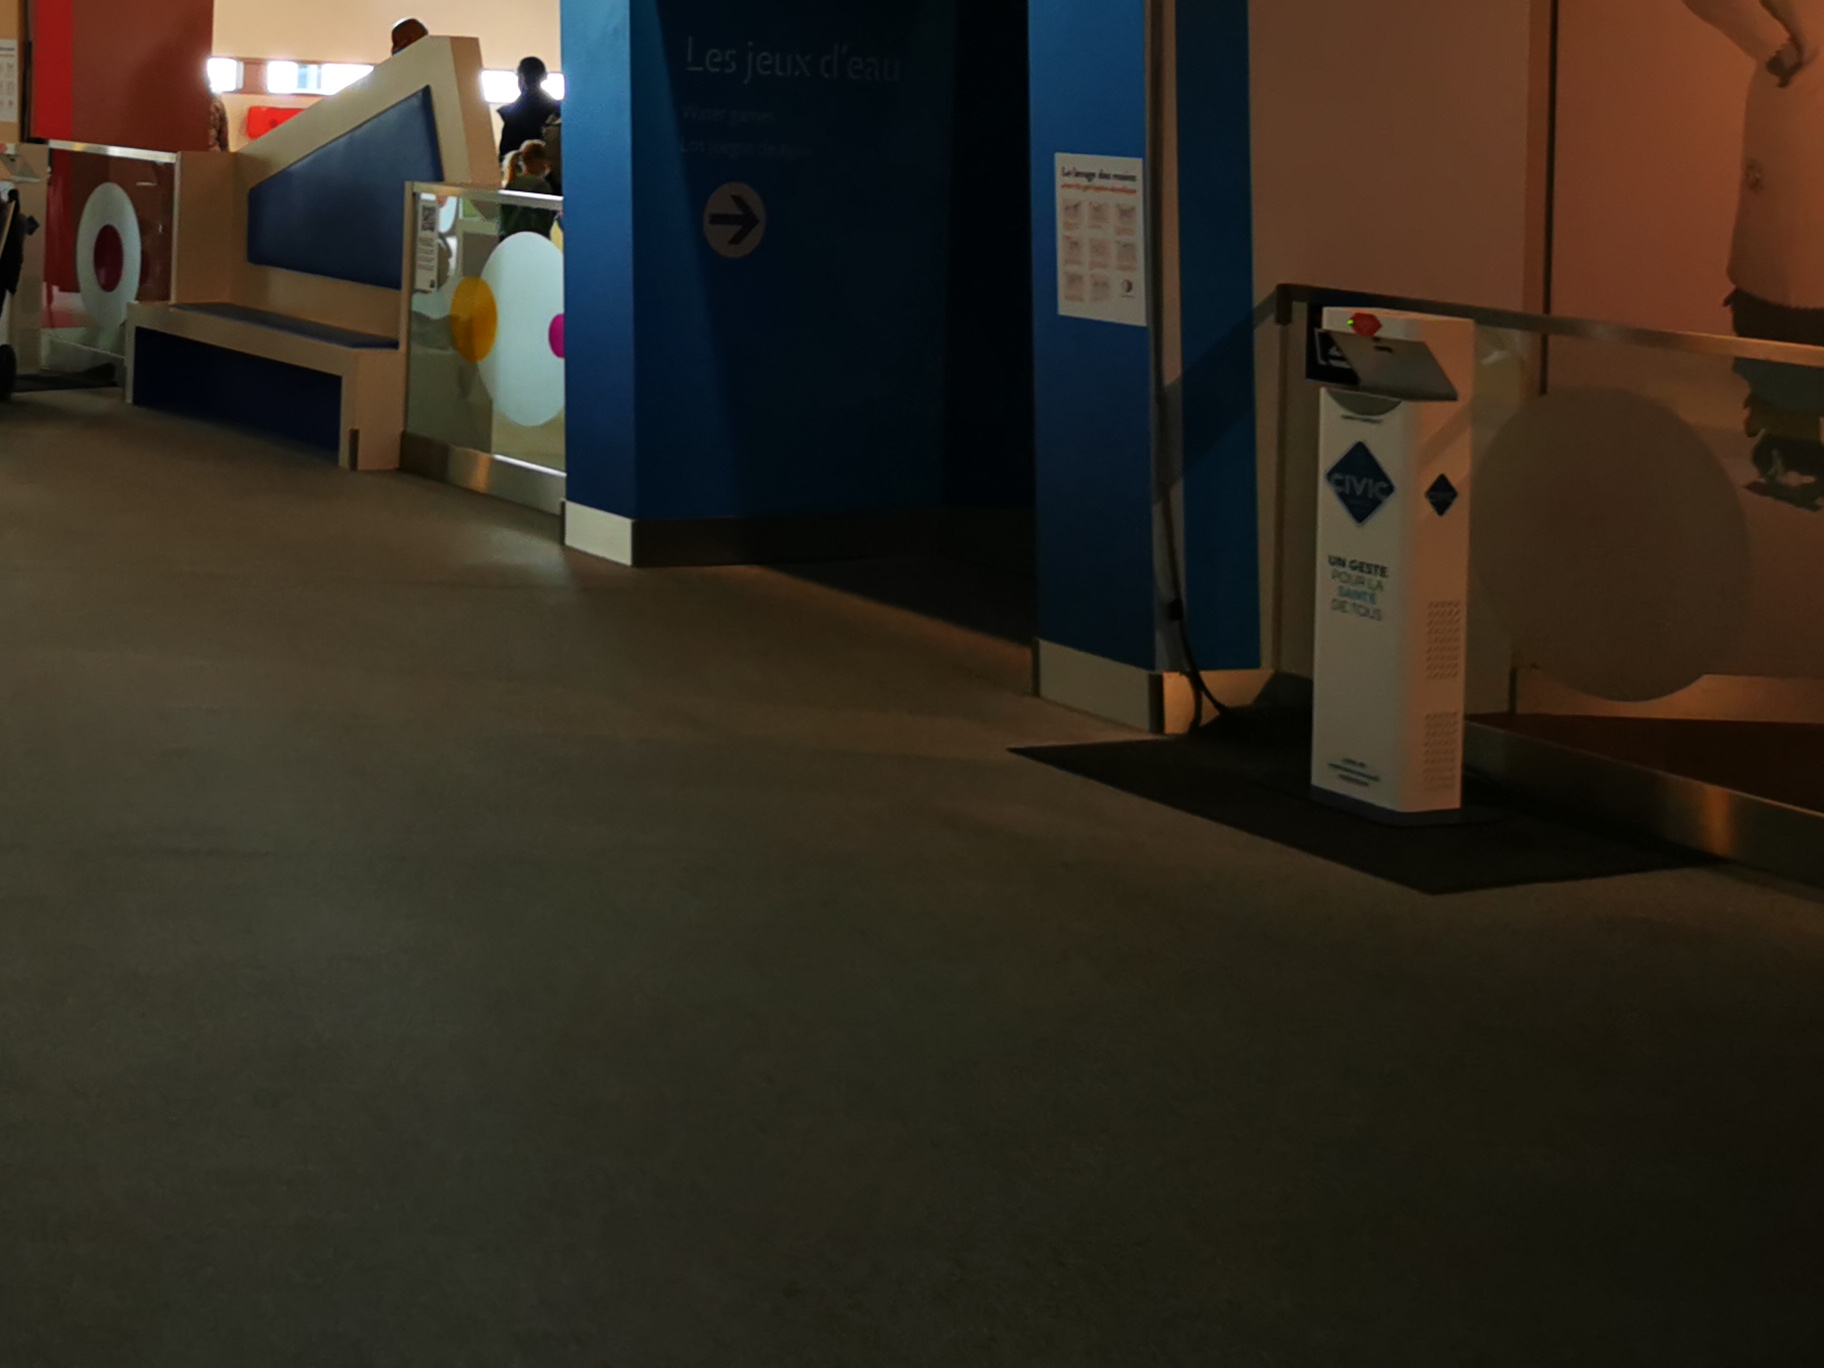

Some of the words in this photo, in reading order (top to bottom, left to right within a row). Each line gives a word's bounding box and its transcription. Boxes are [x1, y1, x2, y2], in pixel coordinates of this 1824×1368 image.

[685, 35, 737, 73] Les
[741, 40, 812, 86] jeux
[818, 41, 901, 83] d'eau
